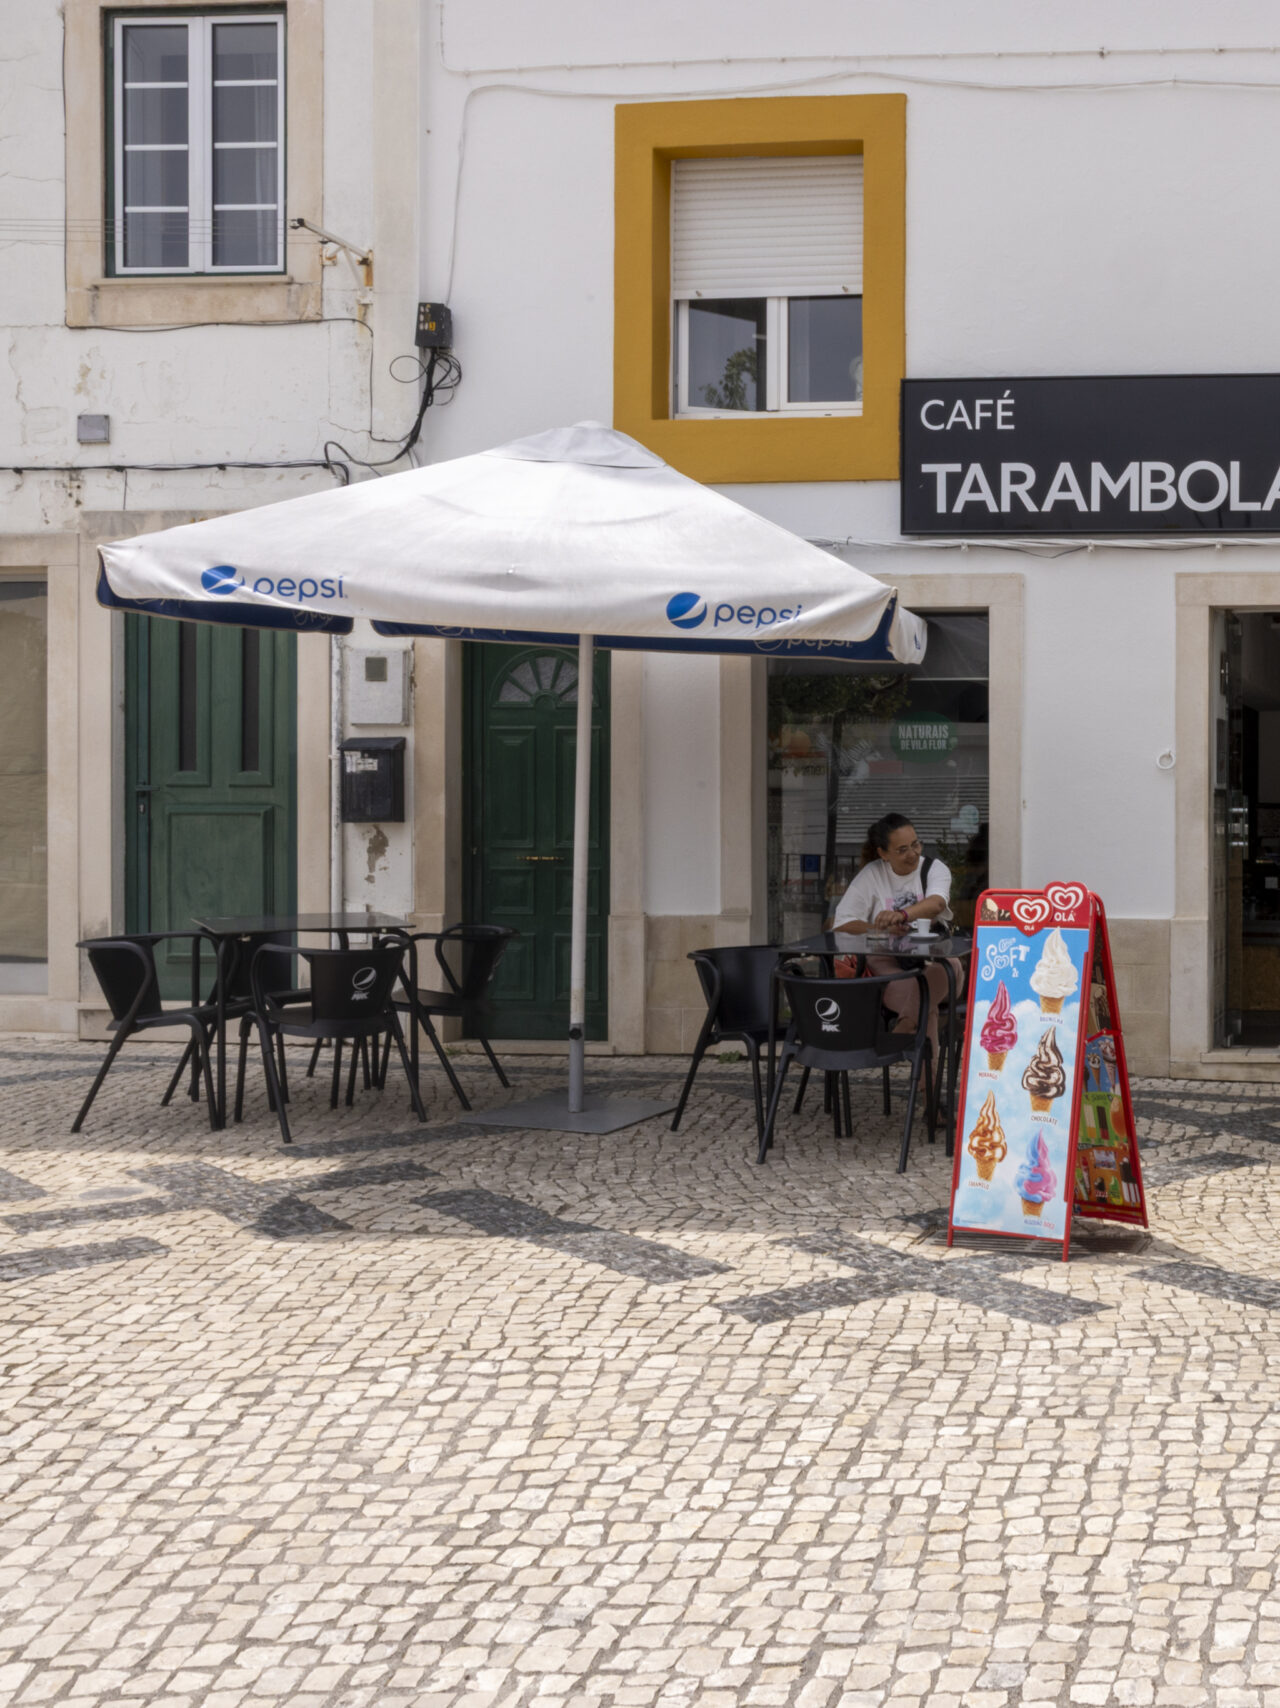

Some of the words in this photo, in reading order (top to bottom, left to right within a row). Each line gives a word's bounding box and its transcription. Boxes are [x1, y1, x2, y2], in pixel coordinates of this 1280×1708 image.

[920, 390, 1015, 431] CAFÉ
[252, 575, 345, 602] pepsi
[714, 603, 802, 629] pepsi
[898, 725, 949, 739] NATURAIS
[901, 740, 911, 750] DE
[912, 740, 929, 750] VILA
[929, 739, 948, 750] FLOR
[1054, 910, 1075, 922] OLÁ
[1030, 1114, 1058, 1126] CHOCOLATE
